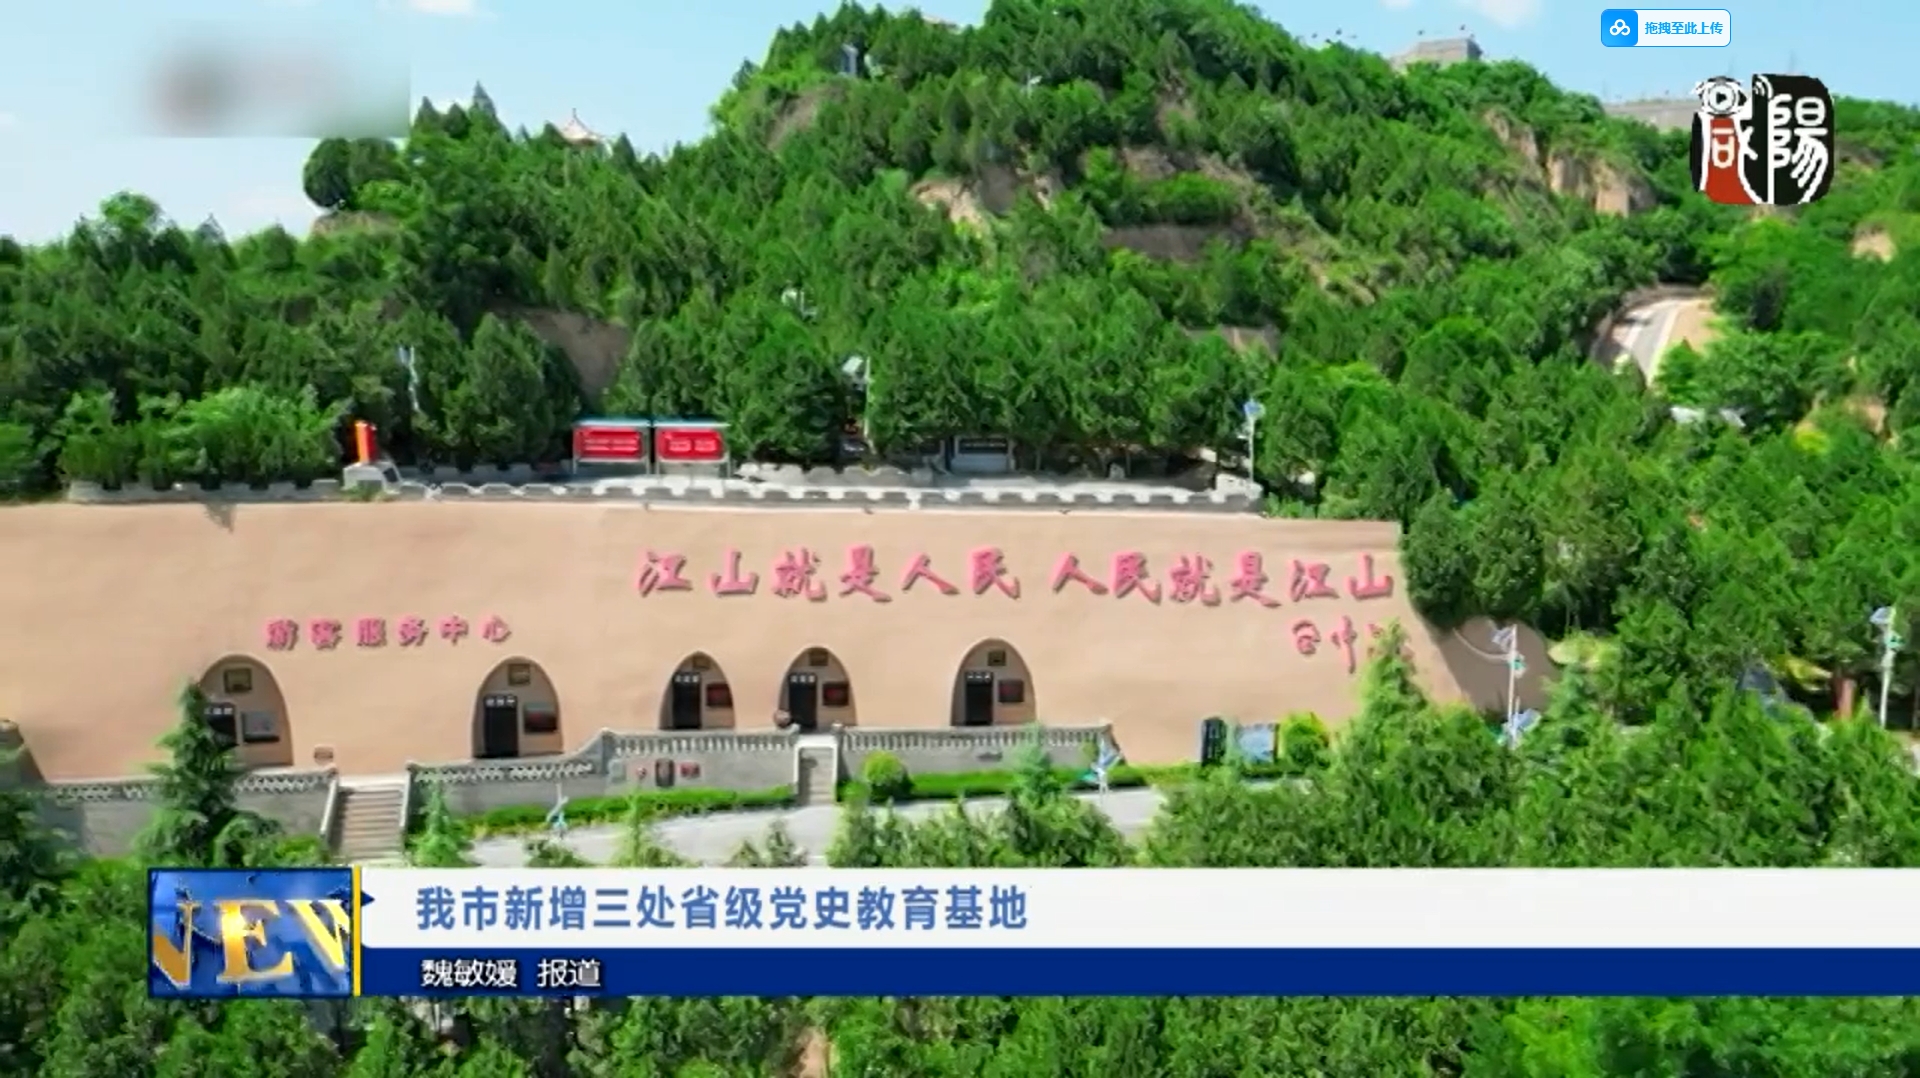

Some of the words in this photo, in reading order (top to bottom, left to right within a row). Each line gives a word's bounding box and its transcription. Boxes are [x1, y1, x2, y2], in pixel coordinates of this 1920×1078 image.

[637, 547, 1020, 602] 江山就是人民
[1049, 549, 1395, 607] 人民就是江山
[264, 615, 511, 650] 游客服务中心
